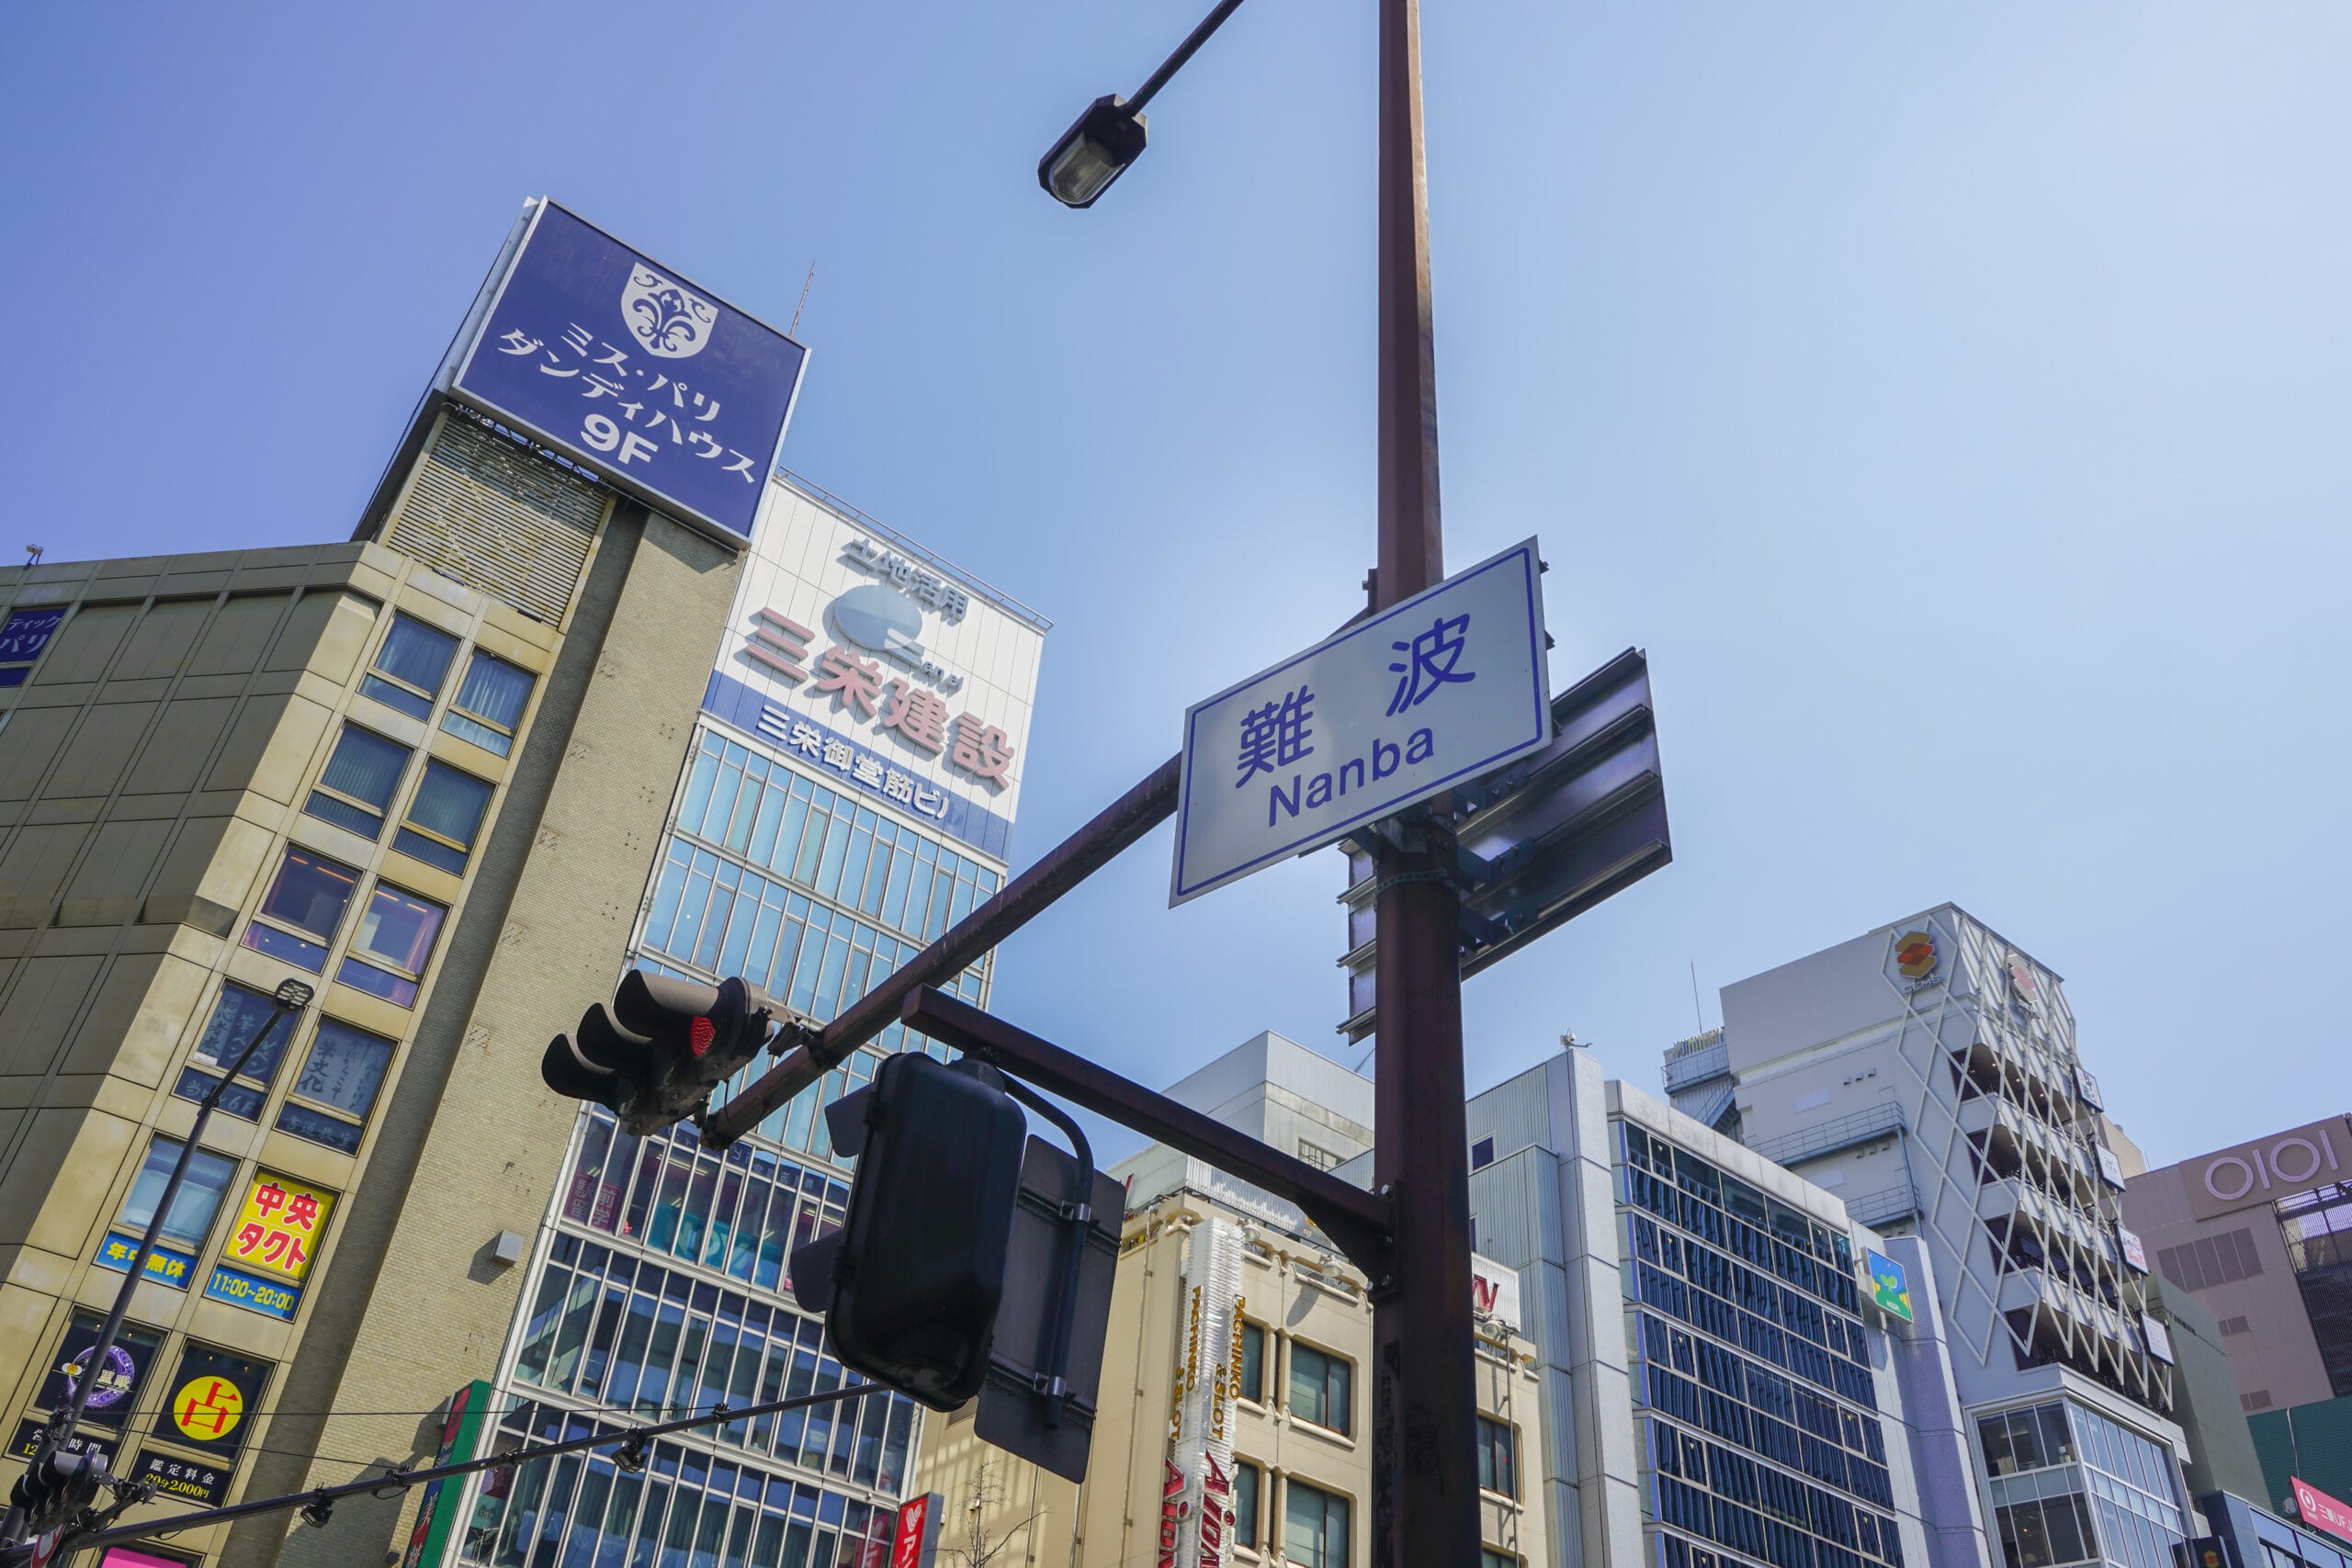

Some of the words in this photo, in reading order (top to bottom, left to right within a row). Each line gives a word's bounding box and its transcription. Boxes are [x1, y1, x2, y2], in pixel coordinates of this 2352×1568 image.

[497, 328, 755, 484] ダンディハウス
[561, 321, 720, 422] ミス・パリ
[580, 413, 659, 465] 9F
[843, 538, 969, 620] 土地活用
[745, 606, 1014, 790] 三栄建設
[1236, 614, 1476, 788] 難波
[1269, 728, 1434, 827] Nanba
[200, 998, 237, 1055] 初心者教
[237, 1223, 307, 1270] タクト
[255, 1182, 319, 1231] 中央
[1186, 1285, 1202, 1393] PACHINKO
[1228, 1293, 1245, 1400] PACHINKO
[181, 1381, 239, 1434] 占
[1171, 1382, 1184, 1440] SLOT
[1212, 1381, 1226, 1440] SLOT
